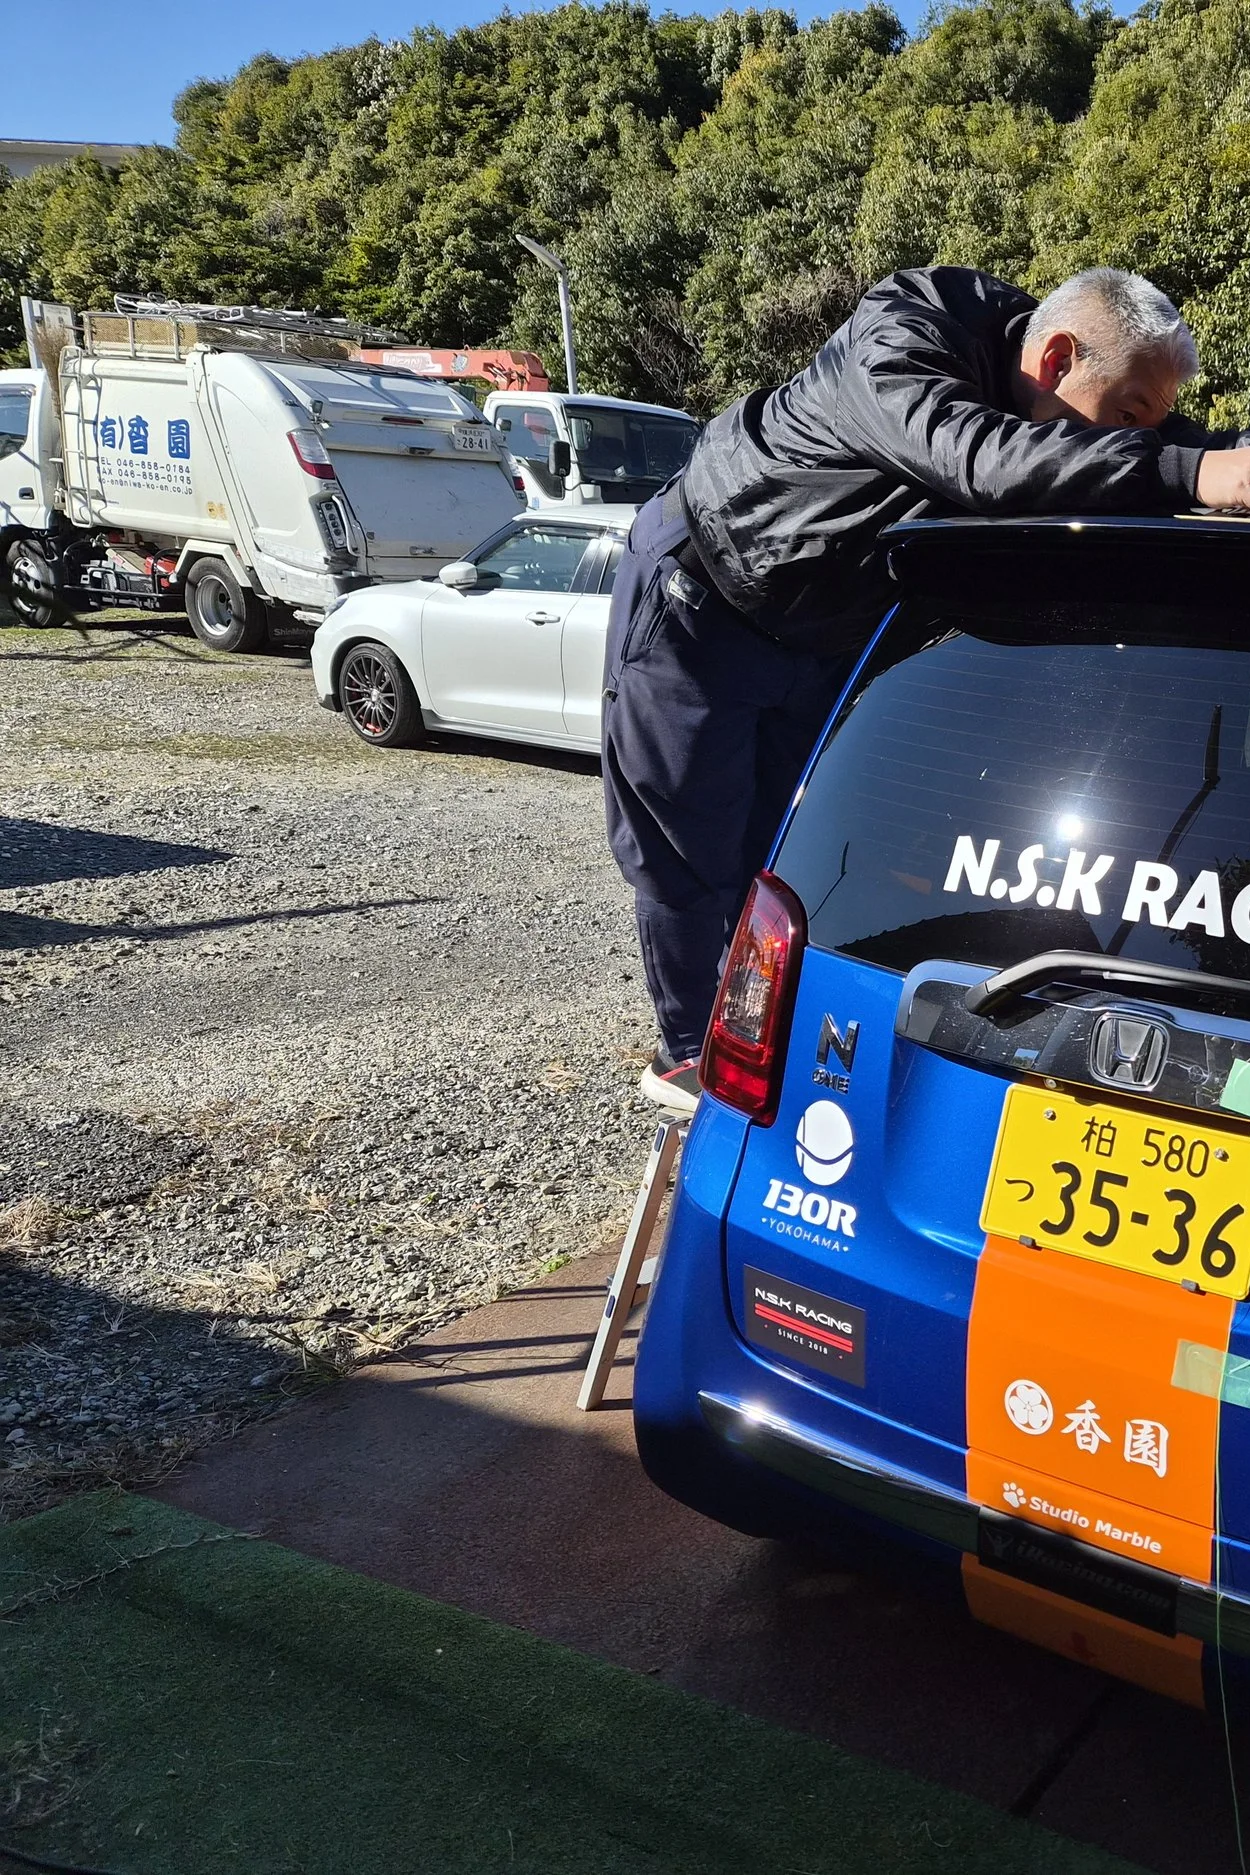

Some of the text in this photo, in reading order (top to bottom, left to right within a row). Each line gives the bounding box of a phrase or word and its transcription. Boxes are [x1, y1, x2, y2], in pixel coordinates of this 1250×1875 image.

[116, 459, 191, 474] 046-858-0184
[462, 436, 489, 450] 28-41
[117, 468, 192, 485] 046-858-0195
[943, 835, 1114, 915] N.S.K
[816, 1012, 860, 1075] N
[1081, 1116, 1210, 1178] 柏 580
[762, 1178, 857, 1238] 130R
[769, 1217, 841, 1252] YOKOHAMA
[1005, 1161, 1245, 1278] つ 35-36
[777, 1328, 829, 1355] SINCE 2018
[795, 1303, 853, 1334] RACING
[1061, 1399, 1170, 1478] 香園
[1028, 1495, 1163, 1555] Studio Marble
